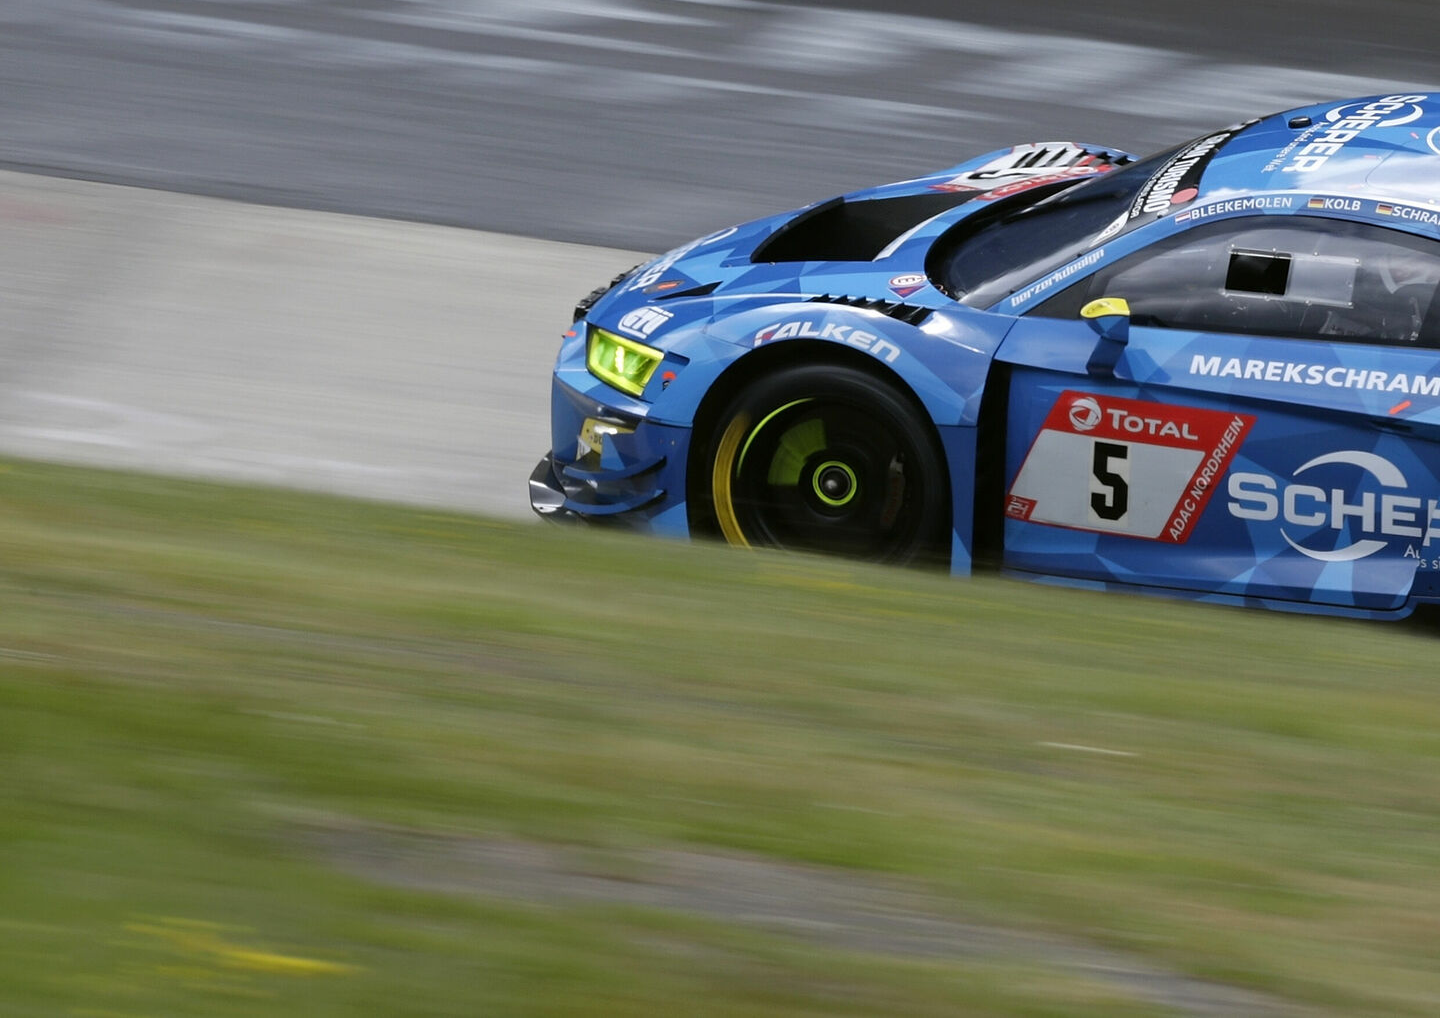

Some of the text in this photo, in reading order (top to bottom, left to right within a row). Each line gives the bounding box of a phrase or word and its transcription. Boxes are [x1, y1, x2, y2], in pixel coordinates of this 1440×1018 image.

[1281, 94, 1428, 173] SCHERER
[1143, 156, 1201, 213] TURISMO
[1191, 197, 1293, 220] BLEEKEMOLEN
[1324, 197, 1361, 211] KOLB
[754, 321, 901, 363] FALKEN
[1106, 408, 1199, 441] TOTAL
[1091, 440, 1129, 521] 5
[1170, 415, 1245, 542] ADAC NORDRHEIN
